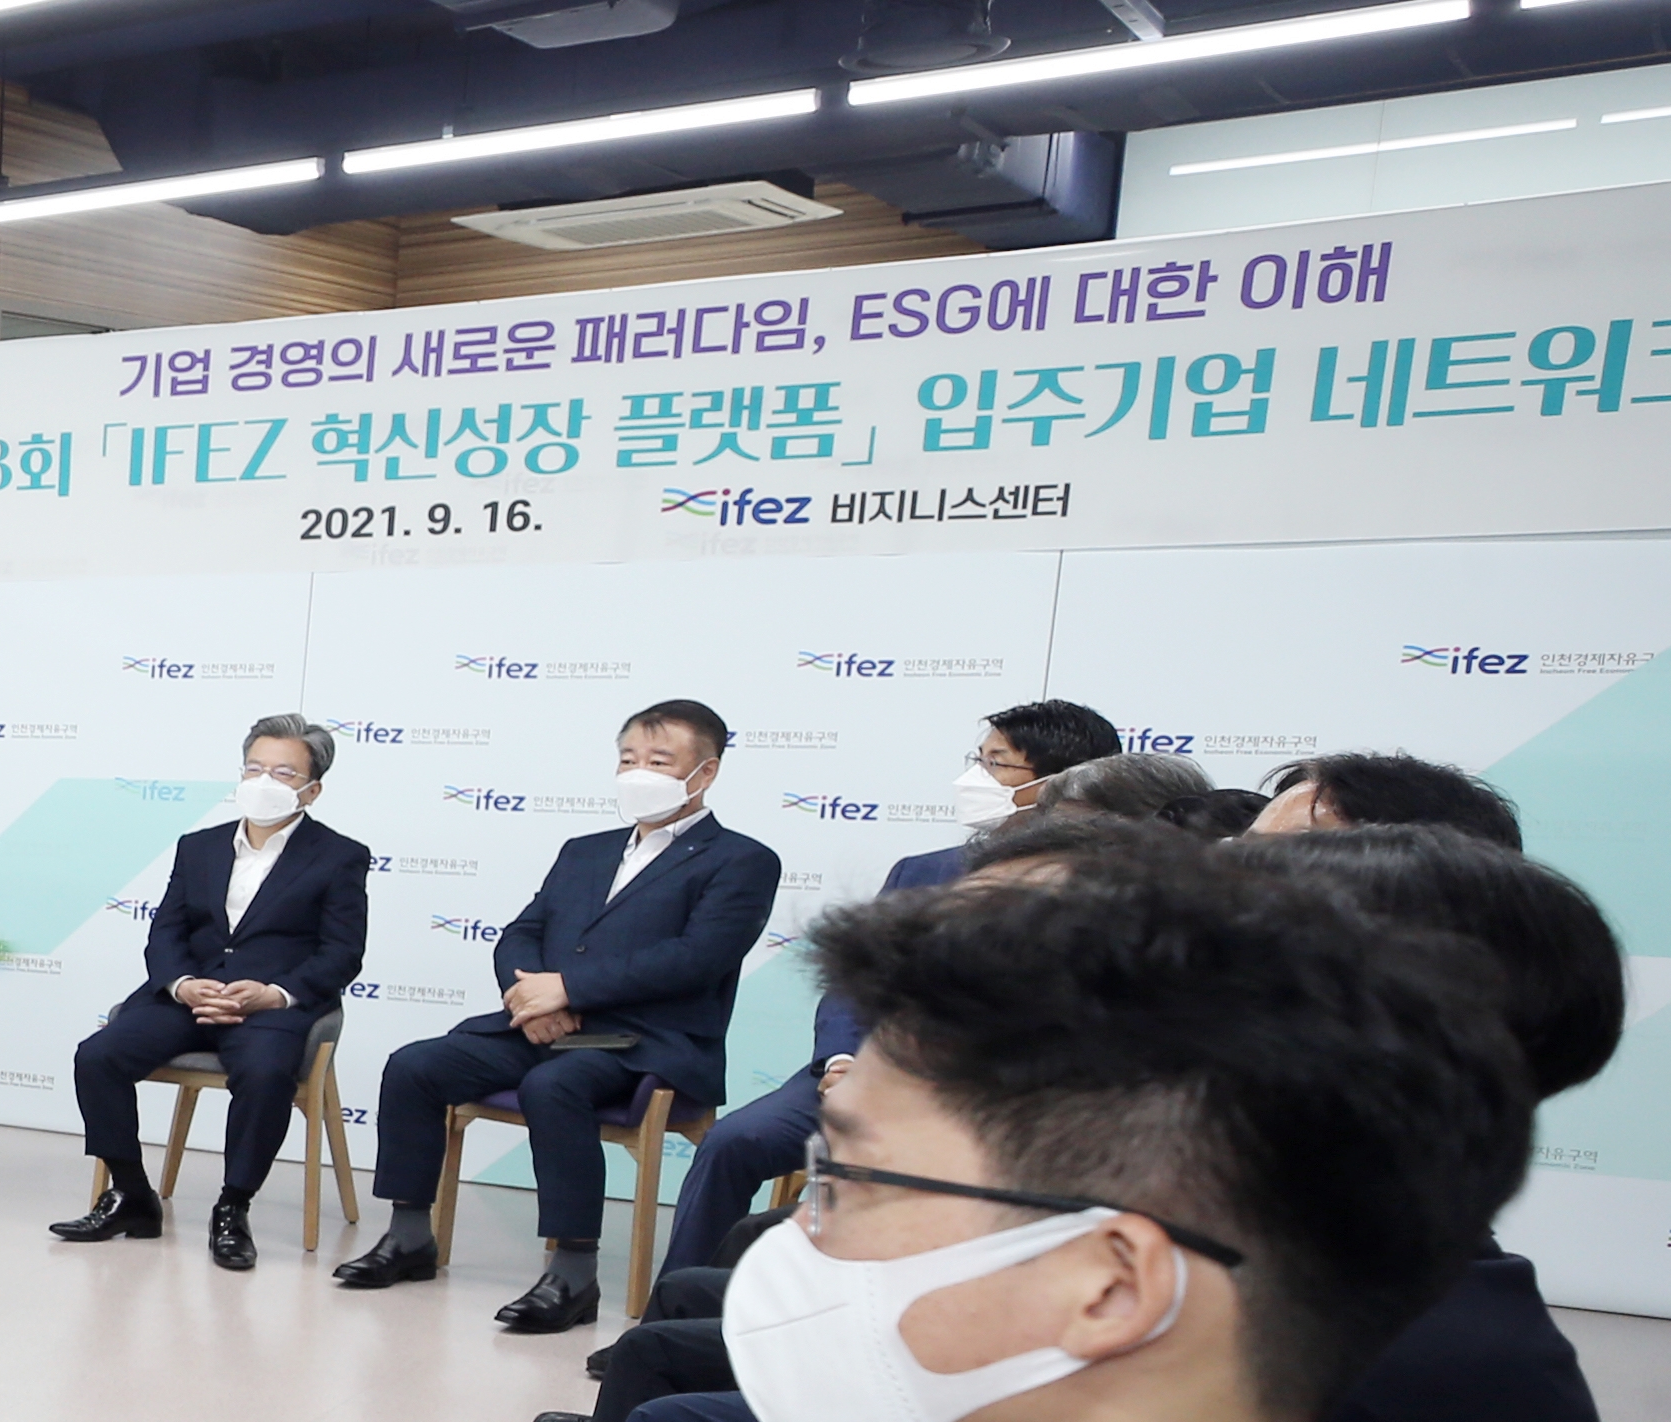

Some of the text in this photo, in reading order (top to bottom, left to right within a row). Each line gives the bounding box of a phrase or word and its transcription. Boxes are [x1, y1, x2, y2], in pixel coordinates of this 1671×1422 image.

[120, 241, 1393, 398] 기업 경영의 새로운 패러다임, ESG에 대한 이해
[311, 398, 591, 482] 혁신성장
[917, 347, 1277, 454] 입주기업
[719, 482, 1071, 527] ifez 비지니스센터
[300, 498, 544, 541] 2021. 9. 16.
[151, 658, 195, 679] ifez
[487, 656, 539, 679] ifez
[835, 652, 1004, 678] ifez 인천경제자유구역
[1451, 647, 1529, 674] ifez
[356, 721, 404, 744] ifez
[745, 731, 838, 743] 인천경제자유구역
[1128, 728, 1318, 754] ifez 인천경제자유구역
[142, 780, 186, 801] ifez
[476, 789, 526, 812] ifez
[820, 796, 879, 820] ifez
[368, 856, 393, 872] ez
[133, 900, 159, 920] ife
[341, 1107, 368, 1124] ez
